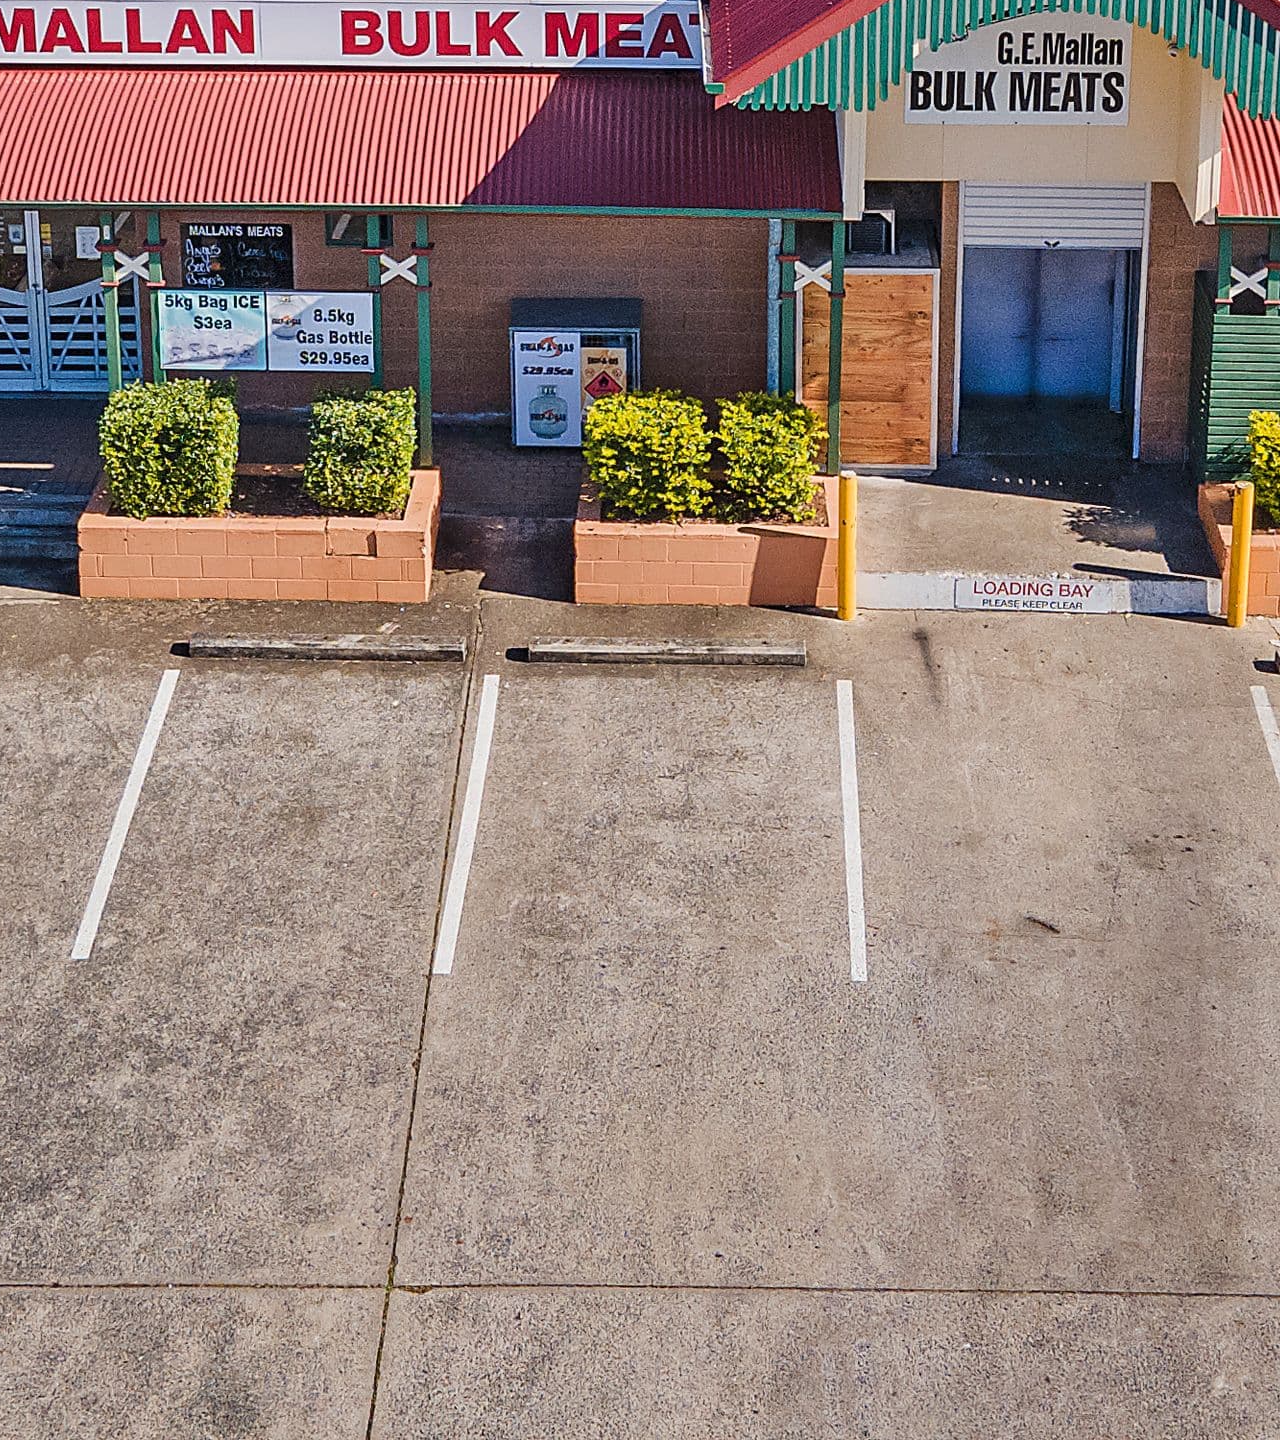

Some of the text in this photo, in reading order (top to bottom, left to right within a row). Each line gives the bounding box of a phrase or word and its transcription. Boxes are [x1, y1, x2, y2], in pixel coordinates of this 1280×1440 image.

[340, 10, 524, 57] BULK
[998, 32, 1124, 65] G.E.Mallan
[909, 70, 1125, 113] BULK MEATS
[189, 225, 284, 236] MALLAN'S MEATS
[165, 295, 260, 311] 5kg Bag ICE
[194, 315, 232, 330] $3ea
[313, 309, 354, 325] 8.5kg
[296, 329, 373, 345] Gas Bottle
[299, 351, 369, 365] $29.95ea
[973, 580, 1094, 598] LOADING BAY
[982, 598, 1083, 610] PLEASE KEEP CLEAR
